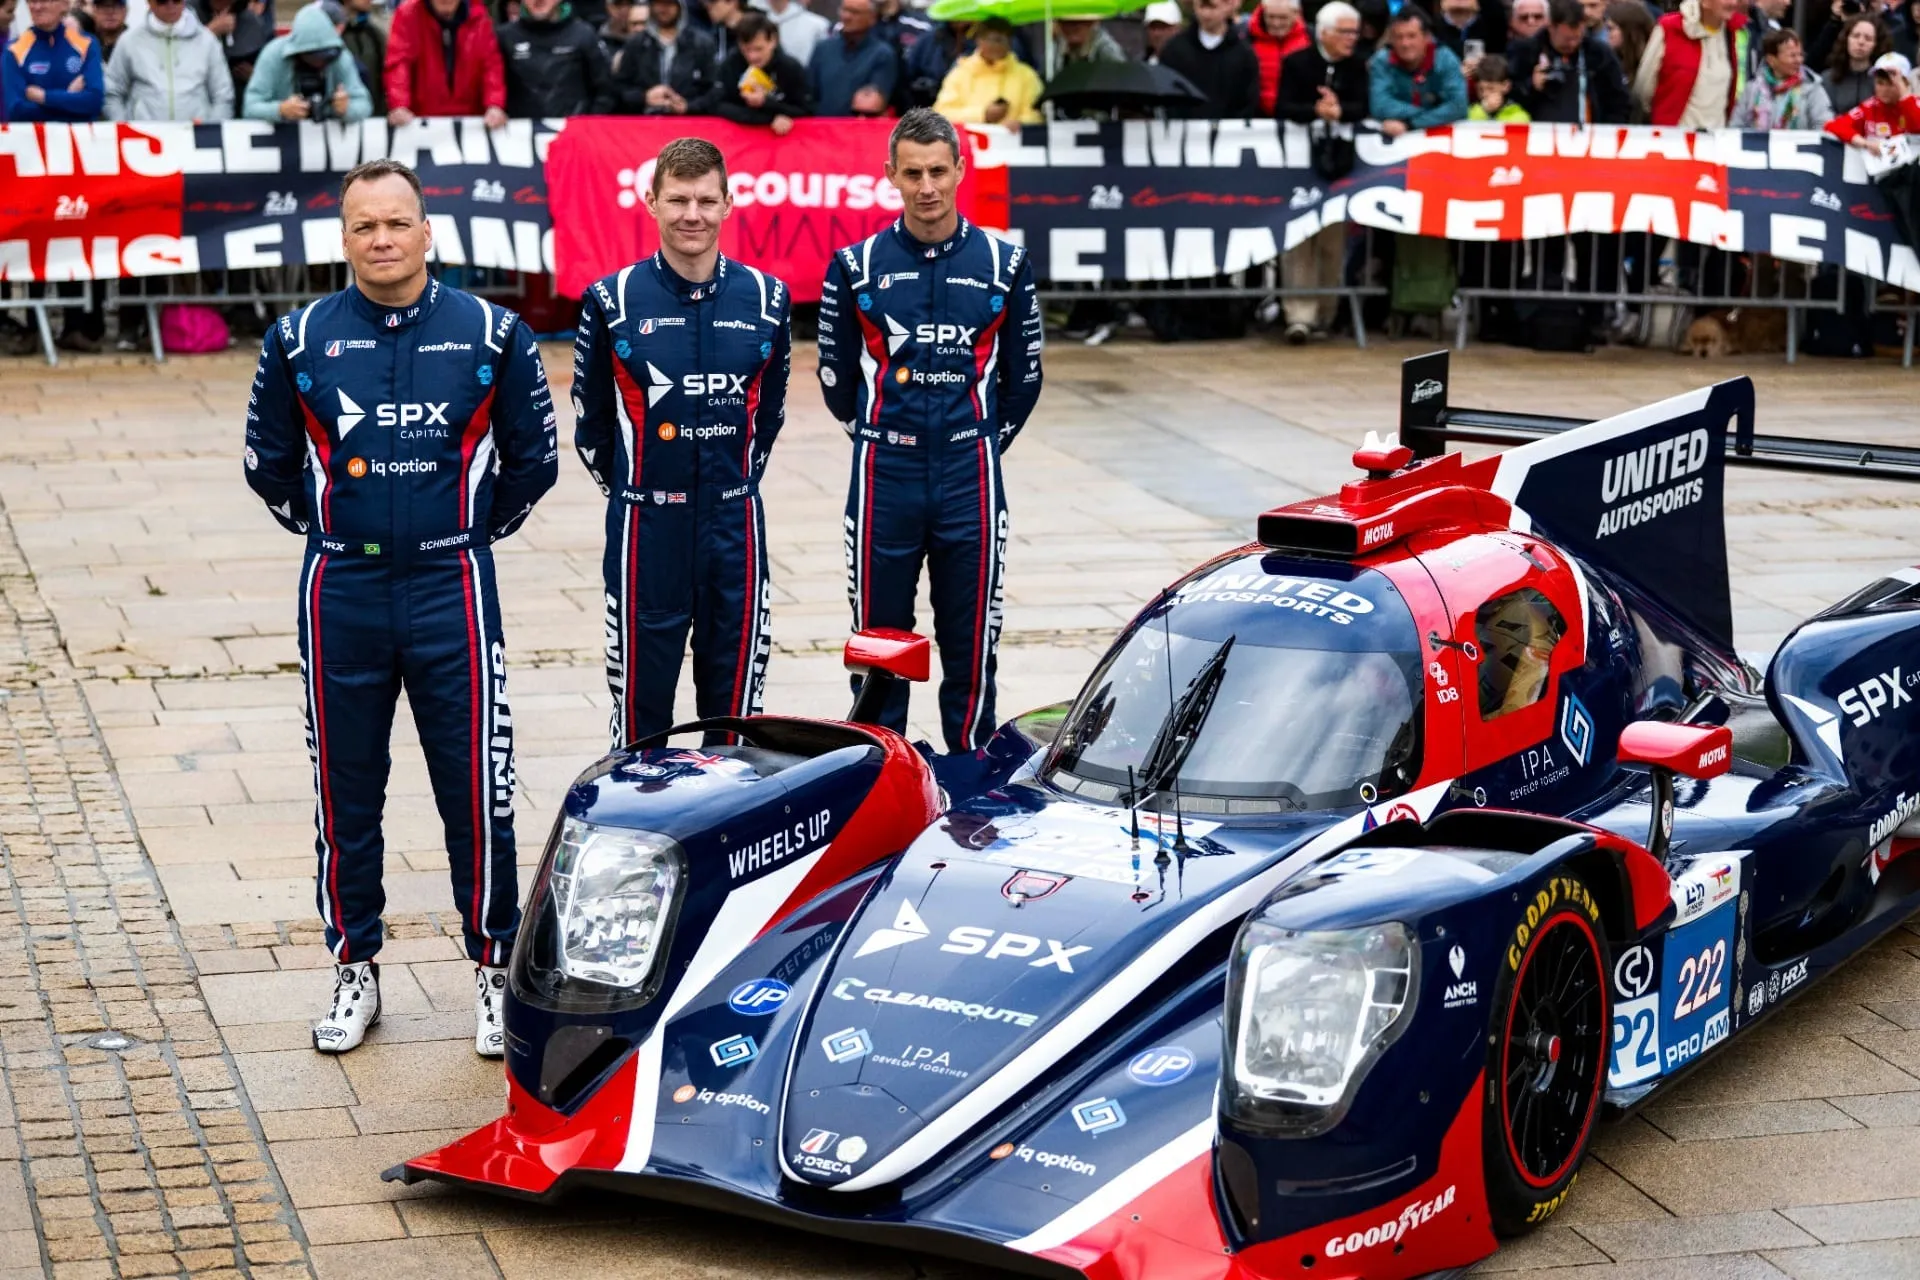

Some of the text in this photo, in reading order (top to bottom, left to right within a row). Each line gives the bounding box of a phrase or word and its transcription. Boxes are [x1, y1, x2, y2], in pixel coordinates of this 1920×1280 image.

[842, 247, 860, 273] HRX
[1007, 246, 1023, 274] HRX
[594, 280, 616, 310] HRX
[407, 307, 420, 318] UP
[496, 311, 515, 339] HRX
[418, 341, 472, 352] GOODYEAR
[916, 324, 977, 346] SPX
[682, 373, 749, 395] SPX
[912, 369, 966, 385] iq option
[376, 402, 450, 427] SPX
[400, 429, 449, 439] CAPITAL
[680, 422, 737, 440] iq option
[860, 427, 881, 439] HRX
[950, 428, 978, 442] JARVIS
[371, 458, 437, 477] iq option
[1602, 428, 1708, 505] UNITED
[621, 490, 645, 502] HRX
[1596, 478, 1704, 540] AUTOSPORTS
[322, 540, 345, 551] HRX
[420, 533, 470, 551] SCHNEIDER
[1363, 521, 1394, 546] MOTUL
[1176, 573, 1375, 615] UNITED
[1159, 591, 1355, 625] AUTOSPORTS
[1436, 687, 1459, 704] ID8
[1837, 666, 1913, 729] SPX
[1520, 744, 1555, 780] IPA
[1698, 744, 1727, 769] MOTUL
[1510, 765, 1570, 801] DEVELOP TOGETHER
[728, 808, 831, 879] WHEELS UP
[1508, 877, 1600, 973] GOODYEAR
[940, 925, 1093, 974] SPX
[1673, 938, 1726, 1021] 222
[1781, 956, 1809, 990] HRX
[732, 984, 788, 1007] UP
[1444, 980, 1477, 1001] ANCH
[863, 988, 1039, 1027] CLEARROUTE
[1665, 1016, 1730, 1069] PRO AM
[871, 1054, 969, 1079] DEVELOP TOGETHER
[901, 1044, 950, 1067] IPA
[1131, 1053, 1190, 1077] UP
[697, 1088, 770, 1115] iq option
[804, 1155, 852, 1175] ORECA
[1015, 1144, 1097, 1176] iq option
[1325, 1185, 1456, 1258] GOODYEAR
